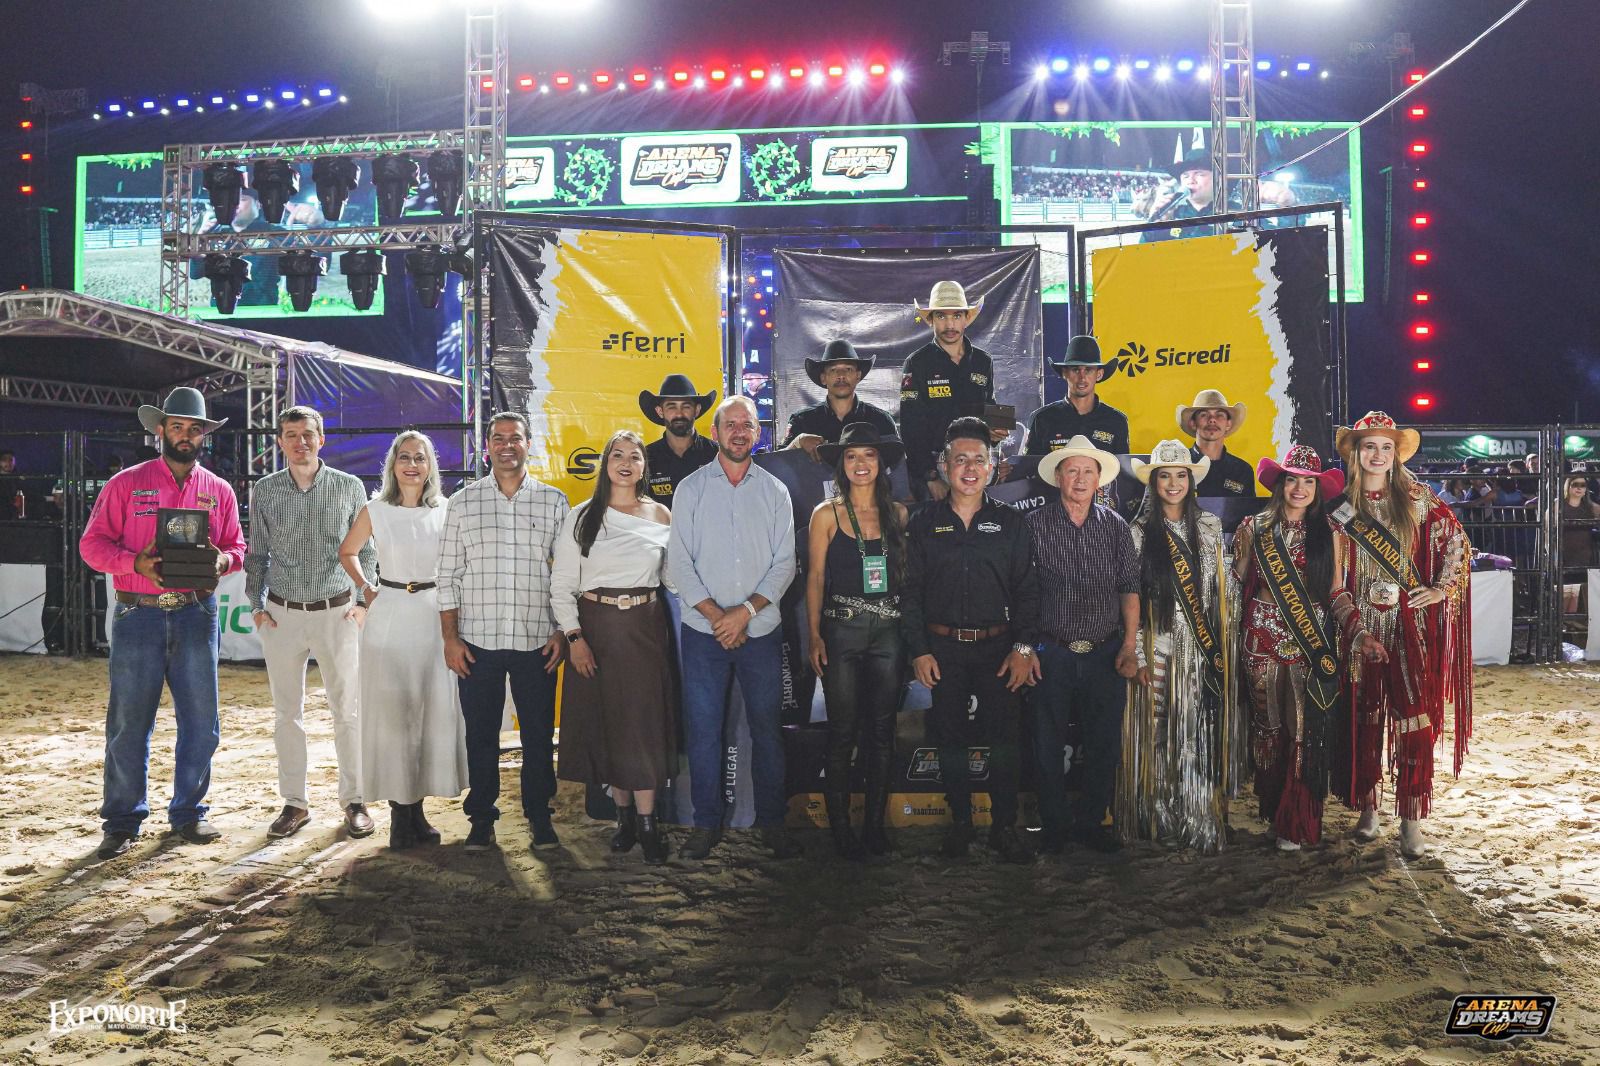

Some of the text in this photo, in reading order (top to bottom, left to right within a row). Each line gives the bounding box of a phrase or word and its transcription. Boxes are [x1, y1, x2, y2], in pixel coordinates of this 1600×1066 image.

[622, 331, 685, 353] ferri
[1154, 343, 1231, 367] Sicredi
[1488, 439, 1527, 456] BAR
[1279, 581, 1323, 650] EXPONORTE
[726, 746, 738, 786] LUGAR
